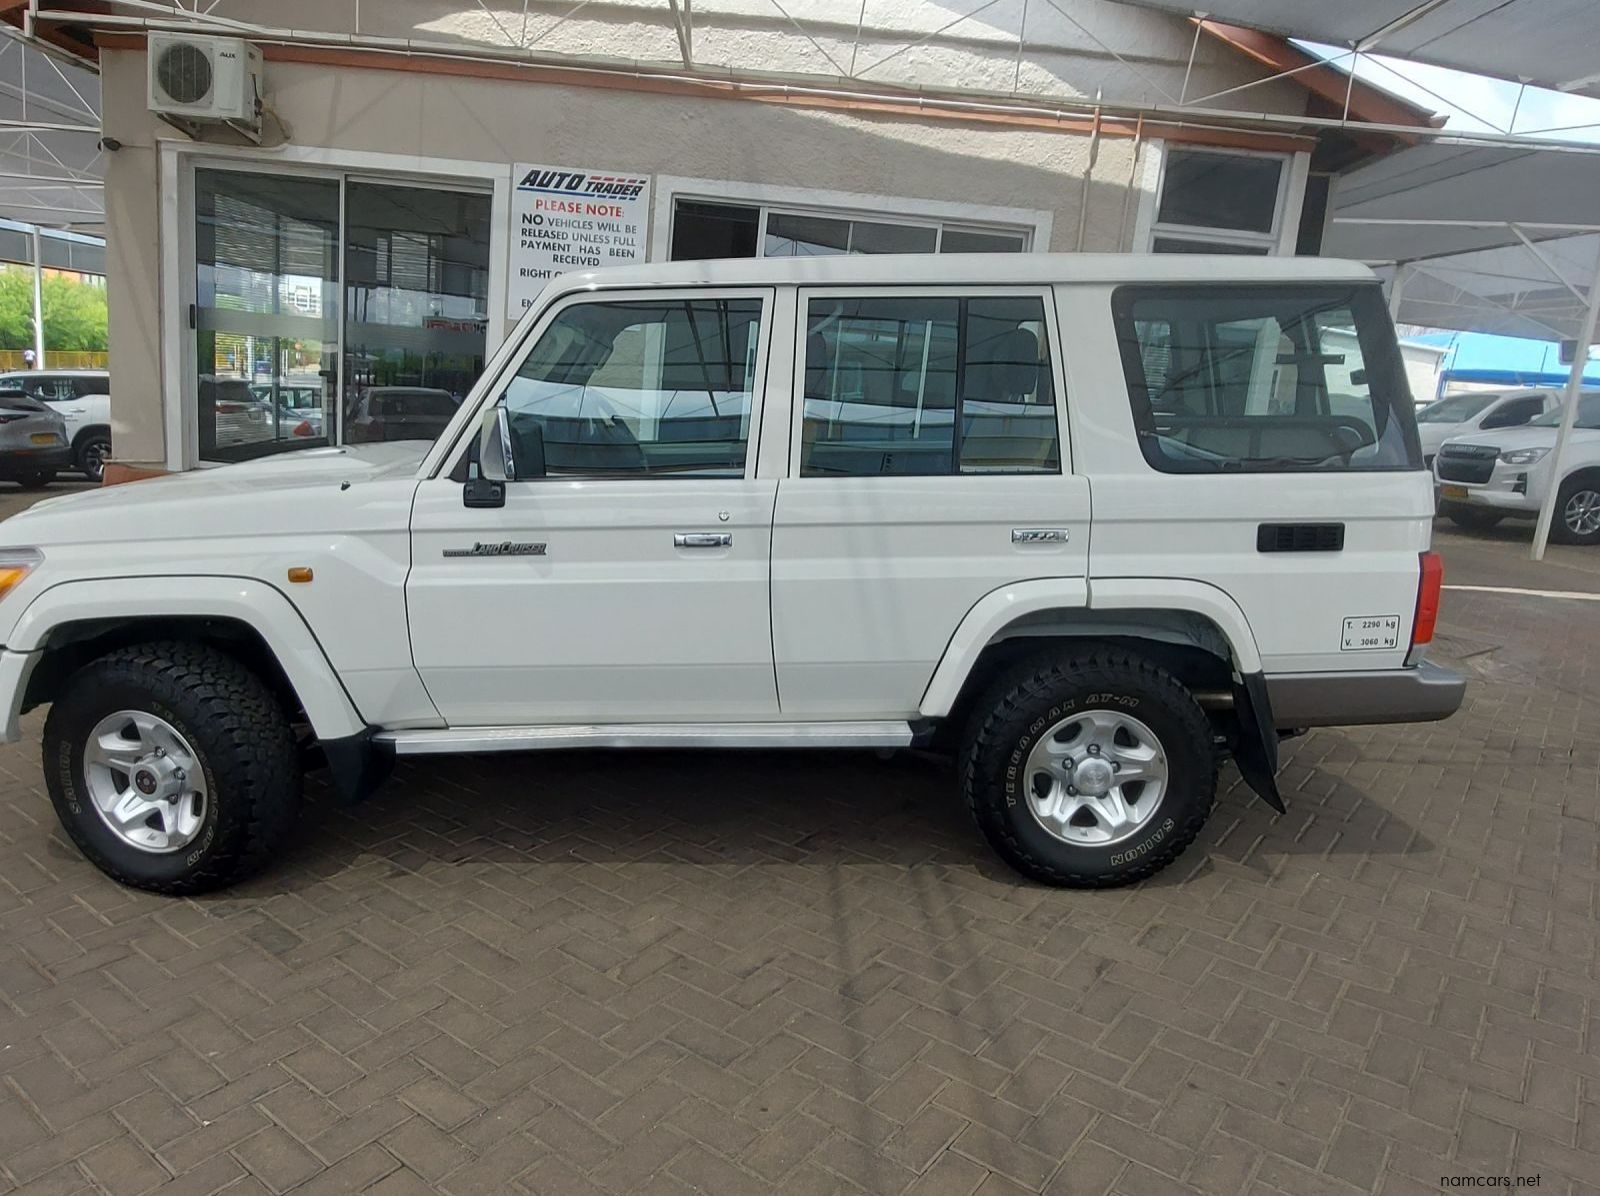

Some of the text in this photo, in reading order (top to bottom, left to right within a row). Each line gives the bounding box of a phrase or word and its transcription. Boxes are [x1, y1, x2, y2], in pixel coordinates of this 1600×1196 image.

[520, 169, 645, 196] AUTO TRADER
[535, 199, 625, 218] PLEASE NOTE:
[522, 213, 637, 234] NO VEHICLES WILL BE
[521, 228, 636, 247] RELEASED UNLESS FULL
[521, 240, 635, 259] PAYMENT HAS BEEN
[552, 254, 600, 267] RECEIVED
[520, 267, 552, 279] RIGHT
[1362, 620, 1381, 629] 2290
[1385, 619, 1396, 629] kg
[1360, 637, 1379, 646] 3060
[1384, 637, 1395, 646] kg
[1111, 817, 1175, 866] SAILUN
